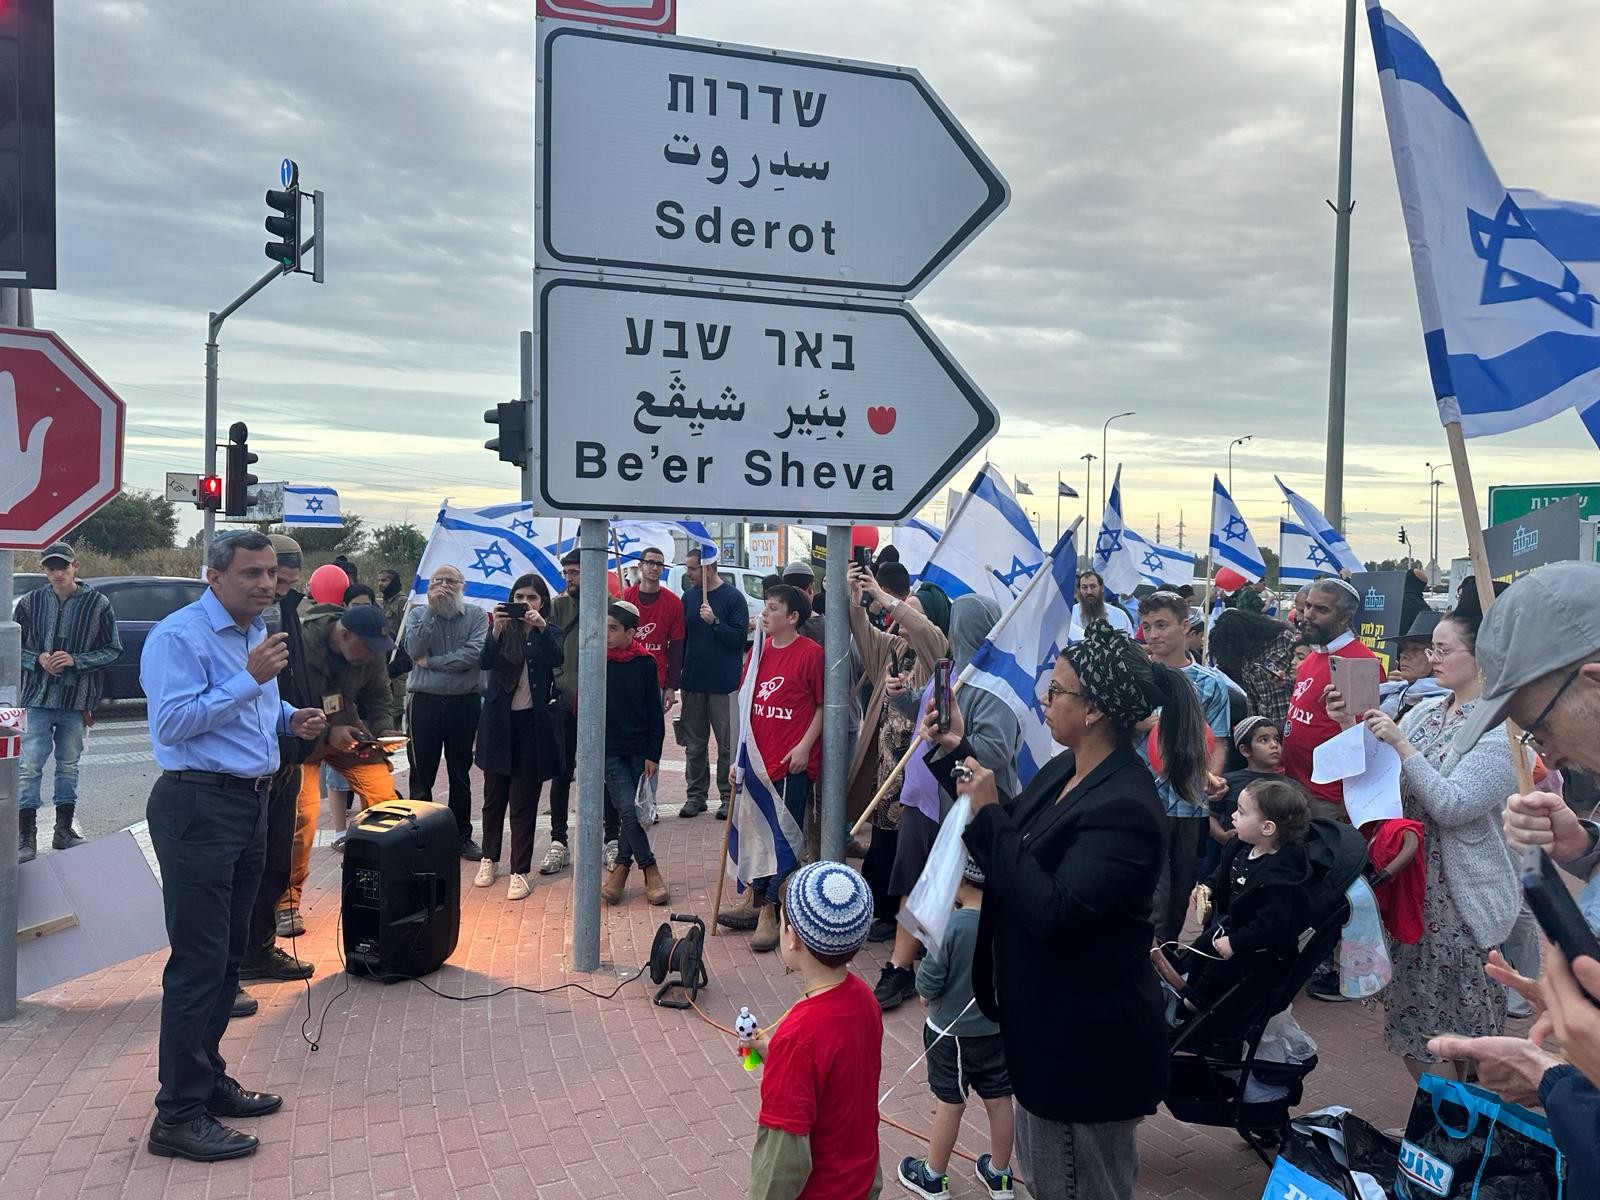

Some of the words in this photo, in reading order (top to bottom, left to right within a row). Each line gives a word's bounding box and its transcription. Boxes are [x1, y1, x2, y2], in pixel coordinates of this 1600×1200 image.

[668, 73, 827, 127] שדרות
[655, 200, 835, 256] Sderot
[626, 318, 731, 360] שבע
[765, 328, 855, 371] באר
[575, 441, 713, 483] Be'er
[744, 449, 894, 491] Sheva
[766, 706, 792, 719] צבע
[1291, 707, 1313, 724] צבע
